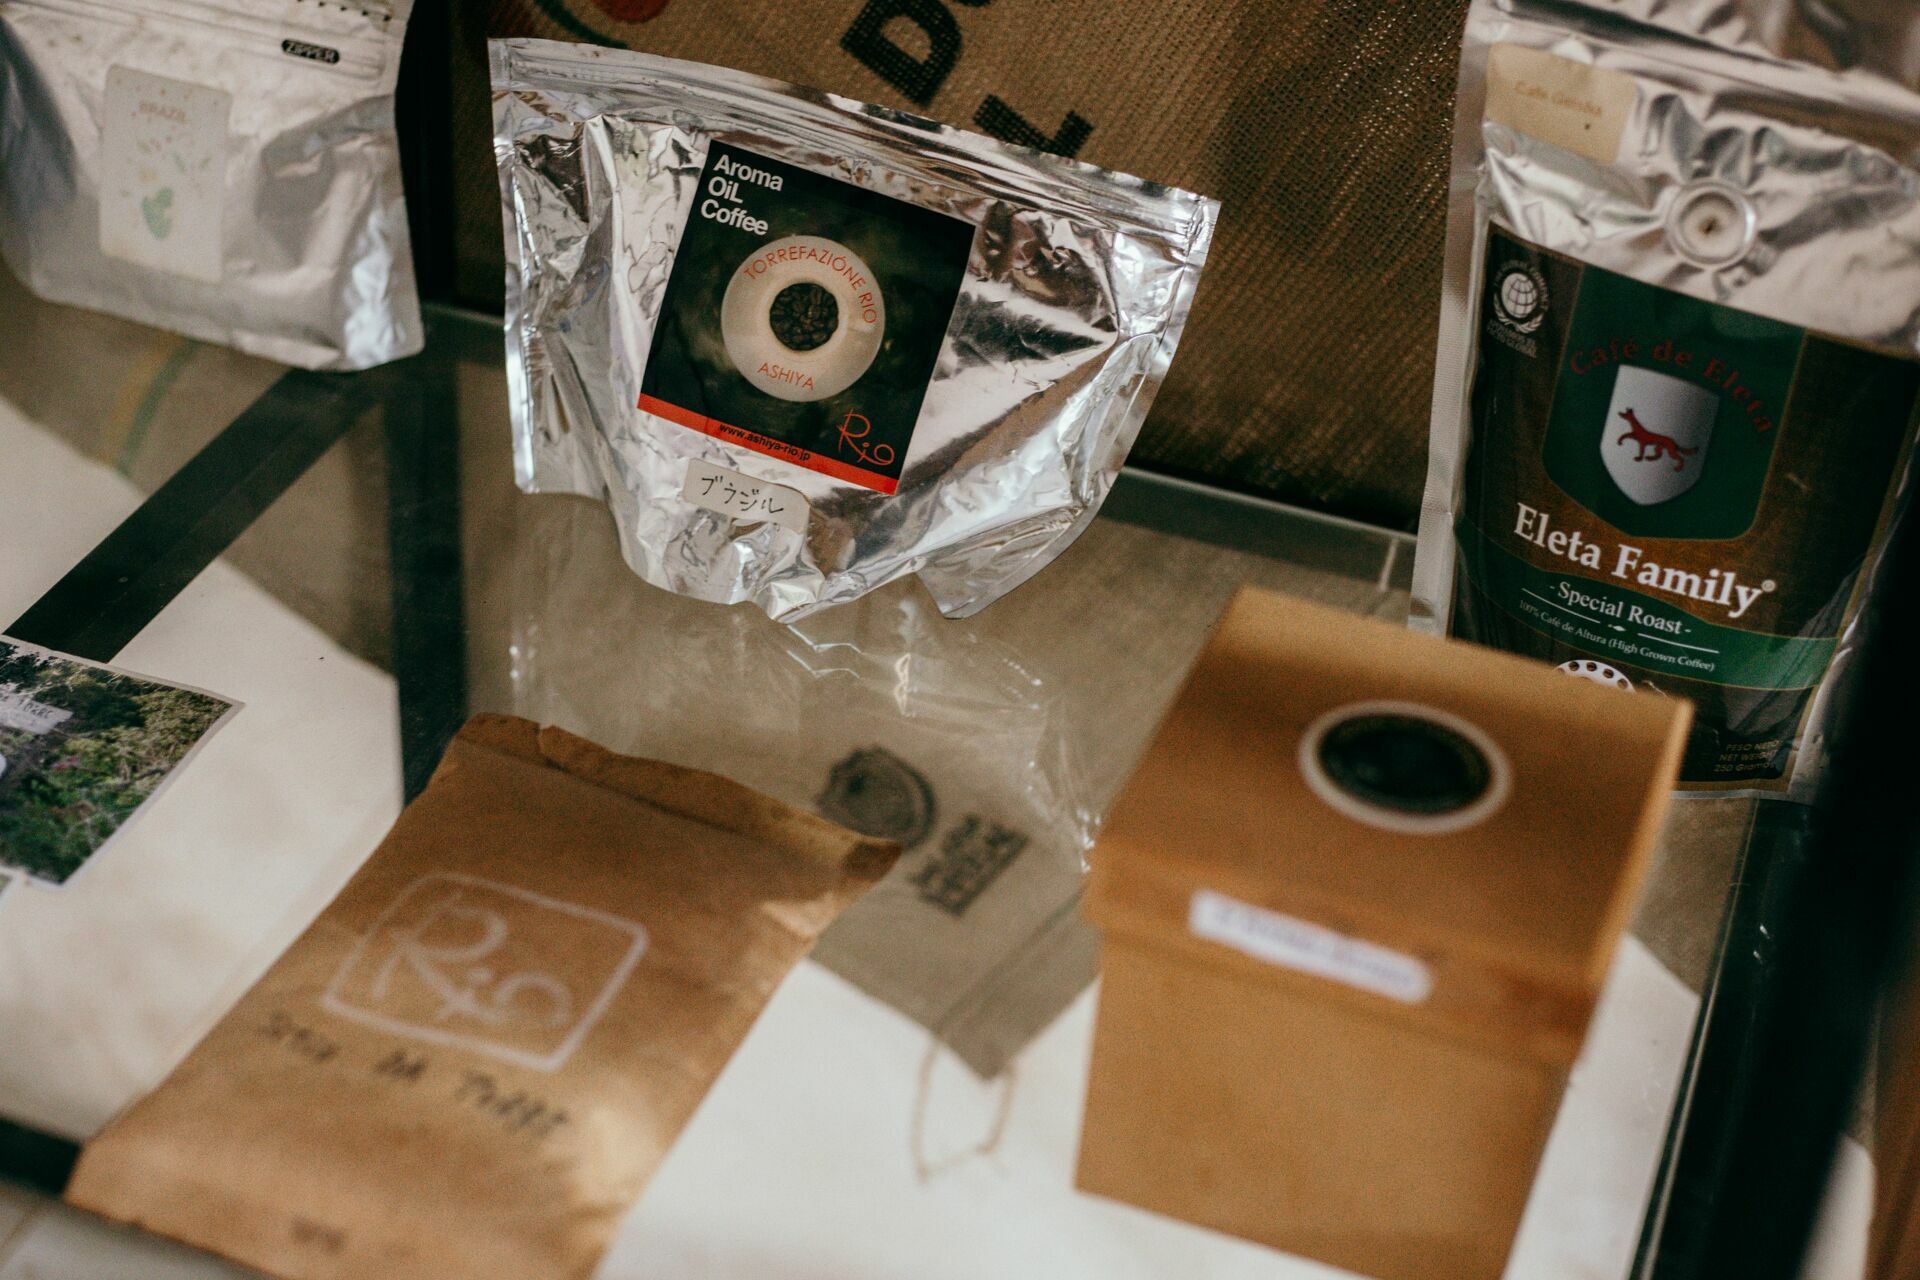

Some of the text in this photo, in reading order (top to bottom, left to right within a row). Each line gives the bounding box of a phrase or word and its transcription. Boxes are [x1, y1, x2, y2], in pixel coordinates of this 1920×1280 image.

[286, 42, 336, 62] ZIPPER
[713, 154, 783, 192] Aroma
[701, 199, 769, 236] Coffee
[858, 291, 878, 324] RIO
[757, 362, 815, 391] ASHIYA
[1653, 339, 1694, 368] de
[1703, 356, 1773, 433] Eleta
[719, 423, 812, 462] www.ashiya-rio.jp
[836, 407, 896, 467] Rio
[701, 475, 785, 515] ブラジル
[1513, 502, 1601, 570] Eleta
[1540, 611, 1561, 629] Café
[1561, 620, 1575, 634] de
[1575, 626, 1607, 646] Altura
[1607, 637, 1639, 654] (High
[1639, 646, 1677, 664] Grown
[1676, 654, 1716, 673] Coffee)
